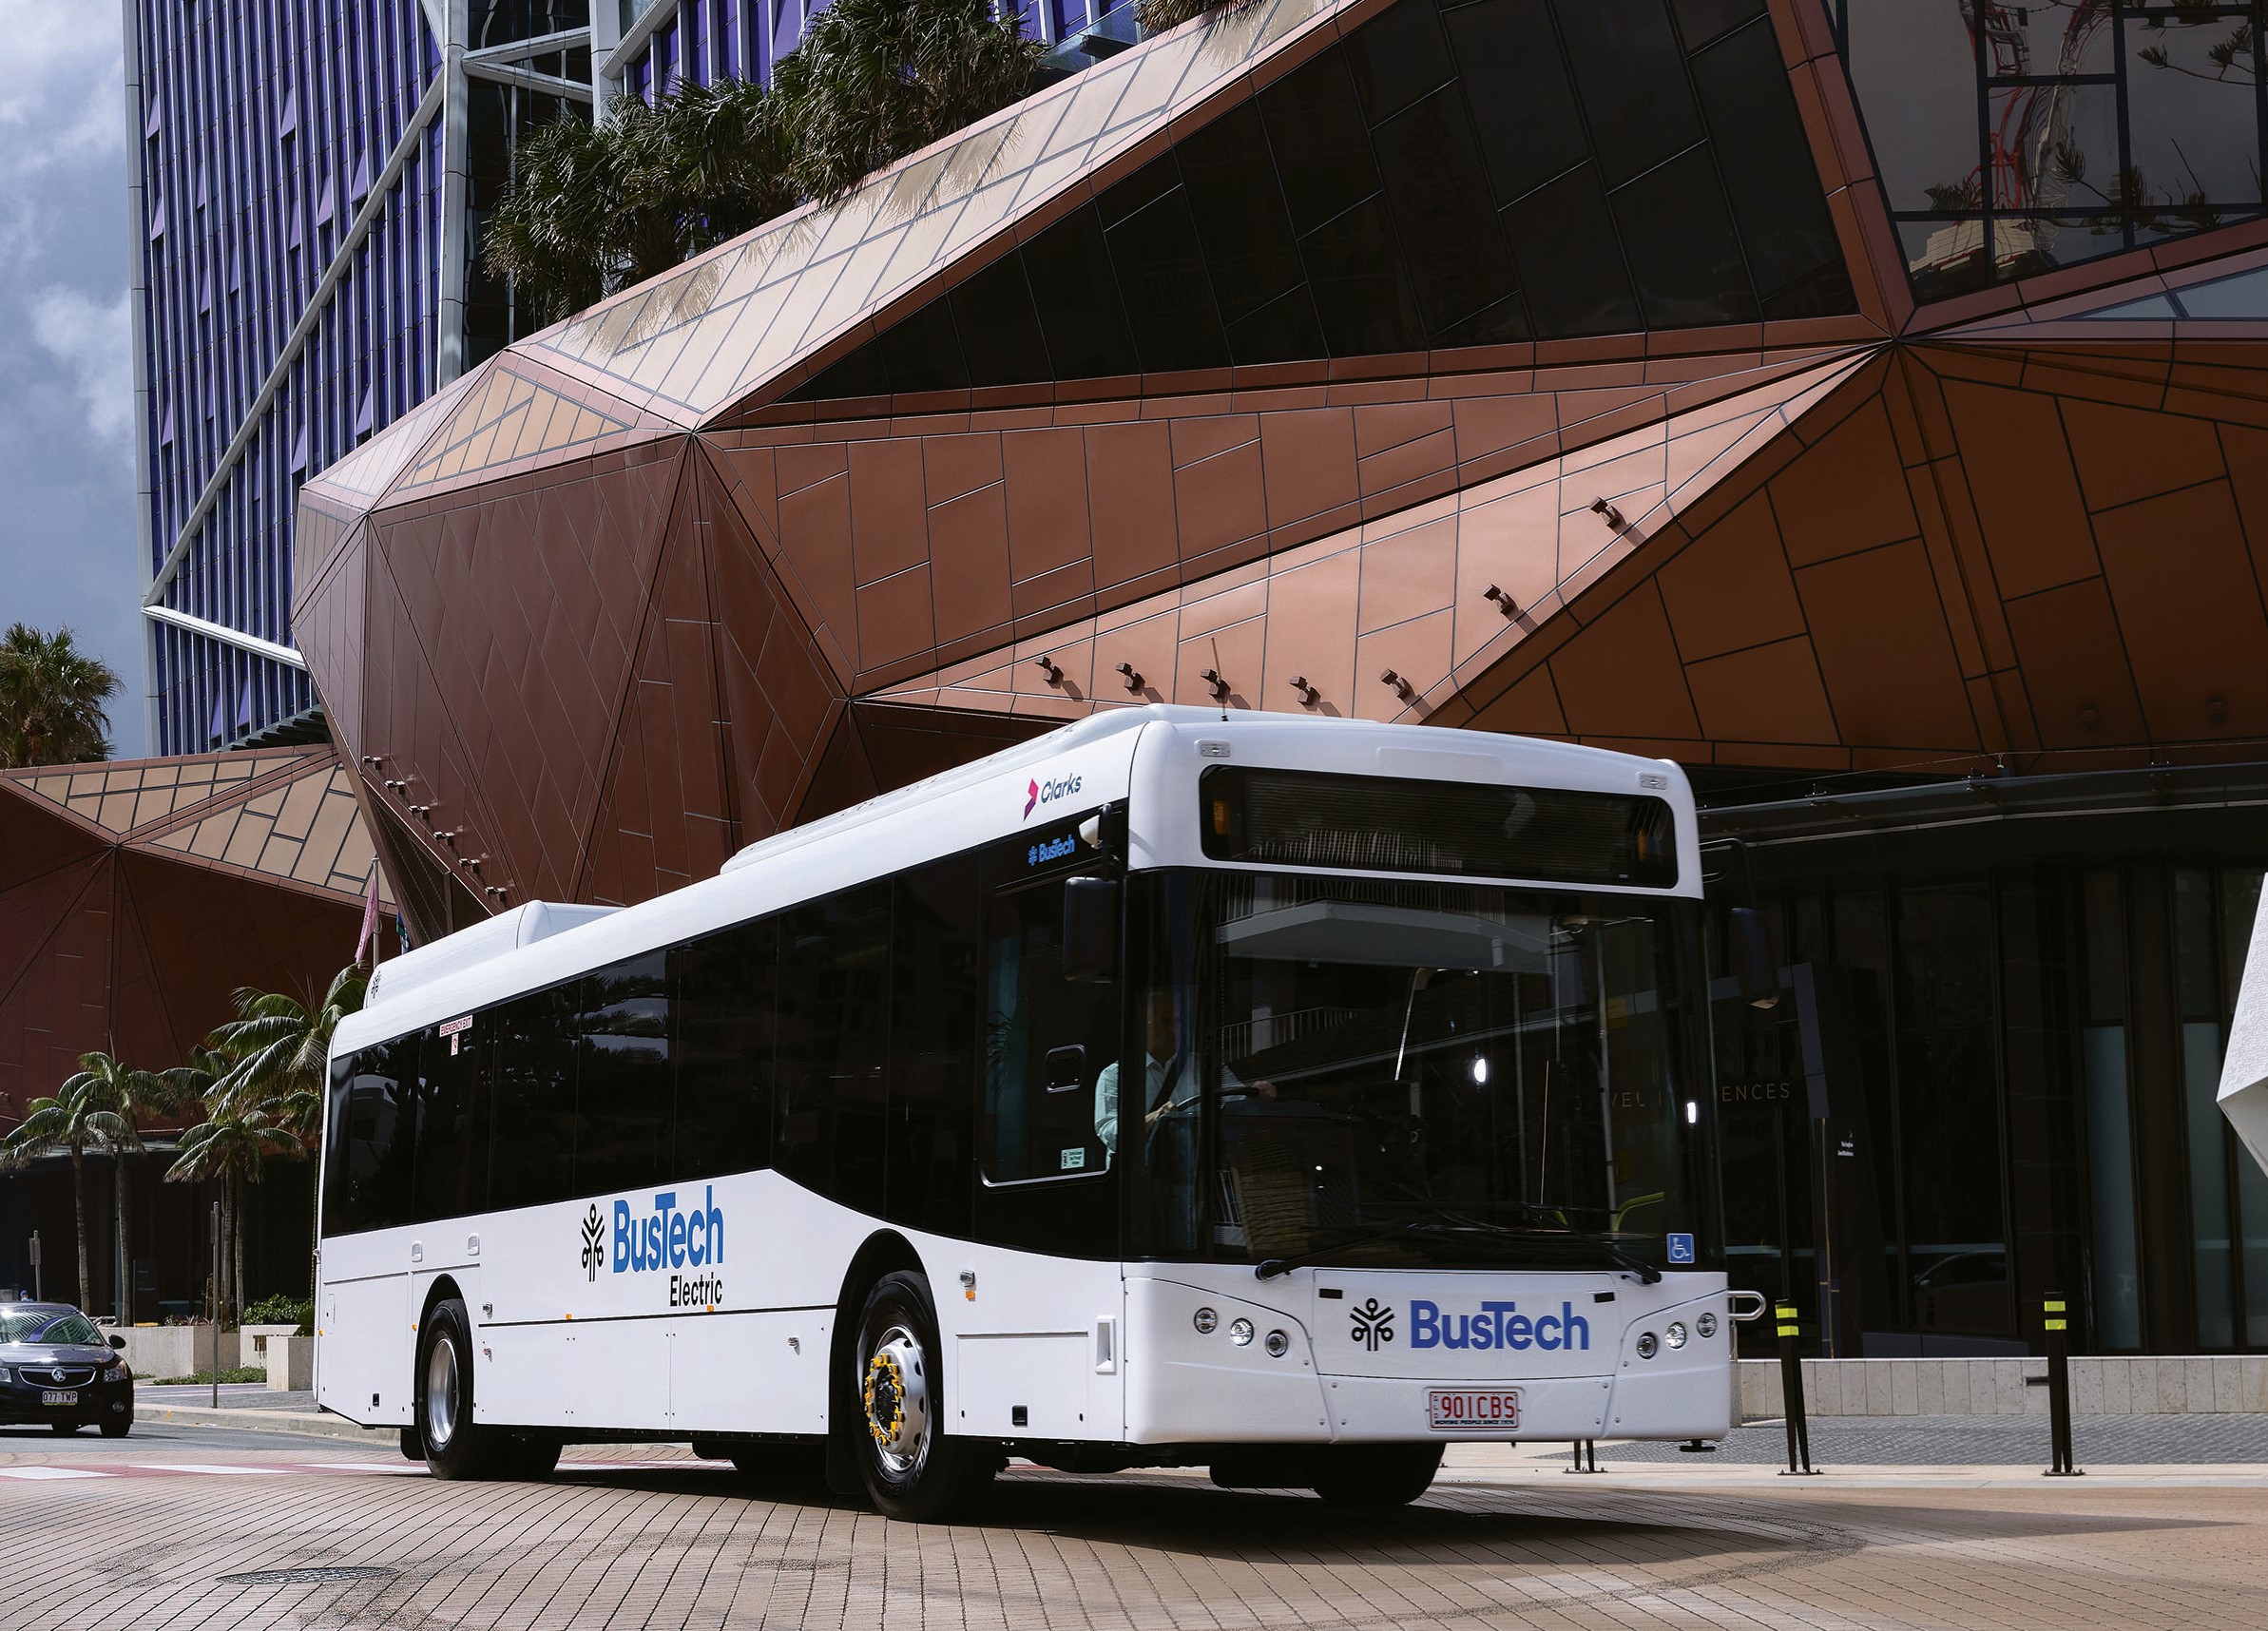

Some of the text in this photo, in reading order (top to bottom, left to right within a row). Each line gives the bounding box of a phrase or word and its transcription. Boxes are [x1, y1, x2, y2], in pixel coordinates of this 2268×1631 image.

[1041, 773, 1082, 803] Clarks
[1039, 835, 1075, 862] BusTech
[441, 1021, 462, 1035] EMERGENCY
[613, 1185, 724, 1273] BusTech
[670, 1272, 722, 1307] Electric
[1411, 1300, 1589, 1351] BusTech
